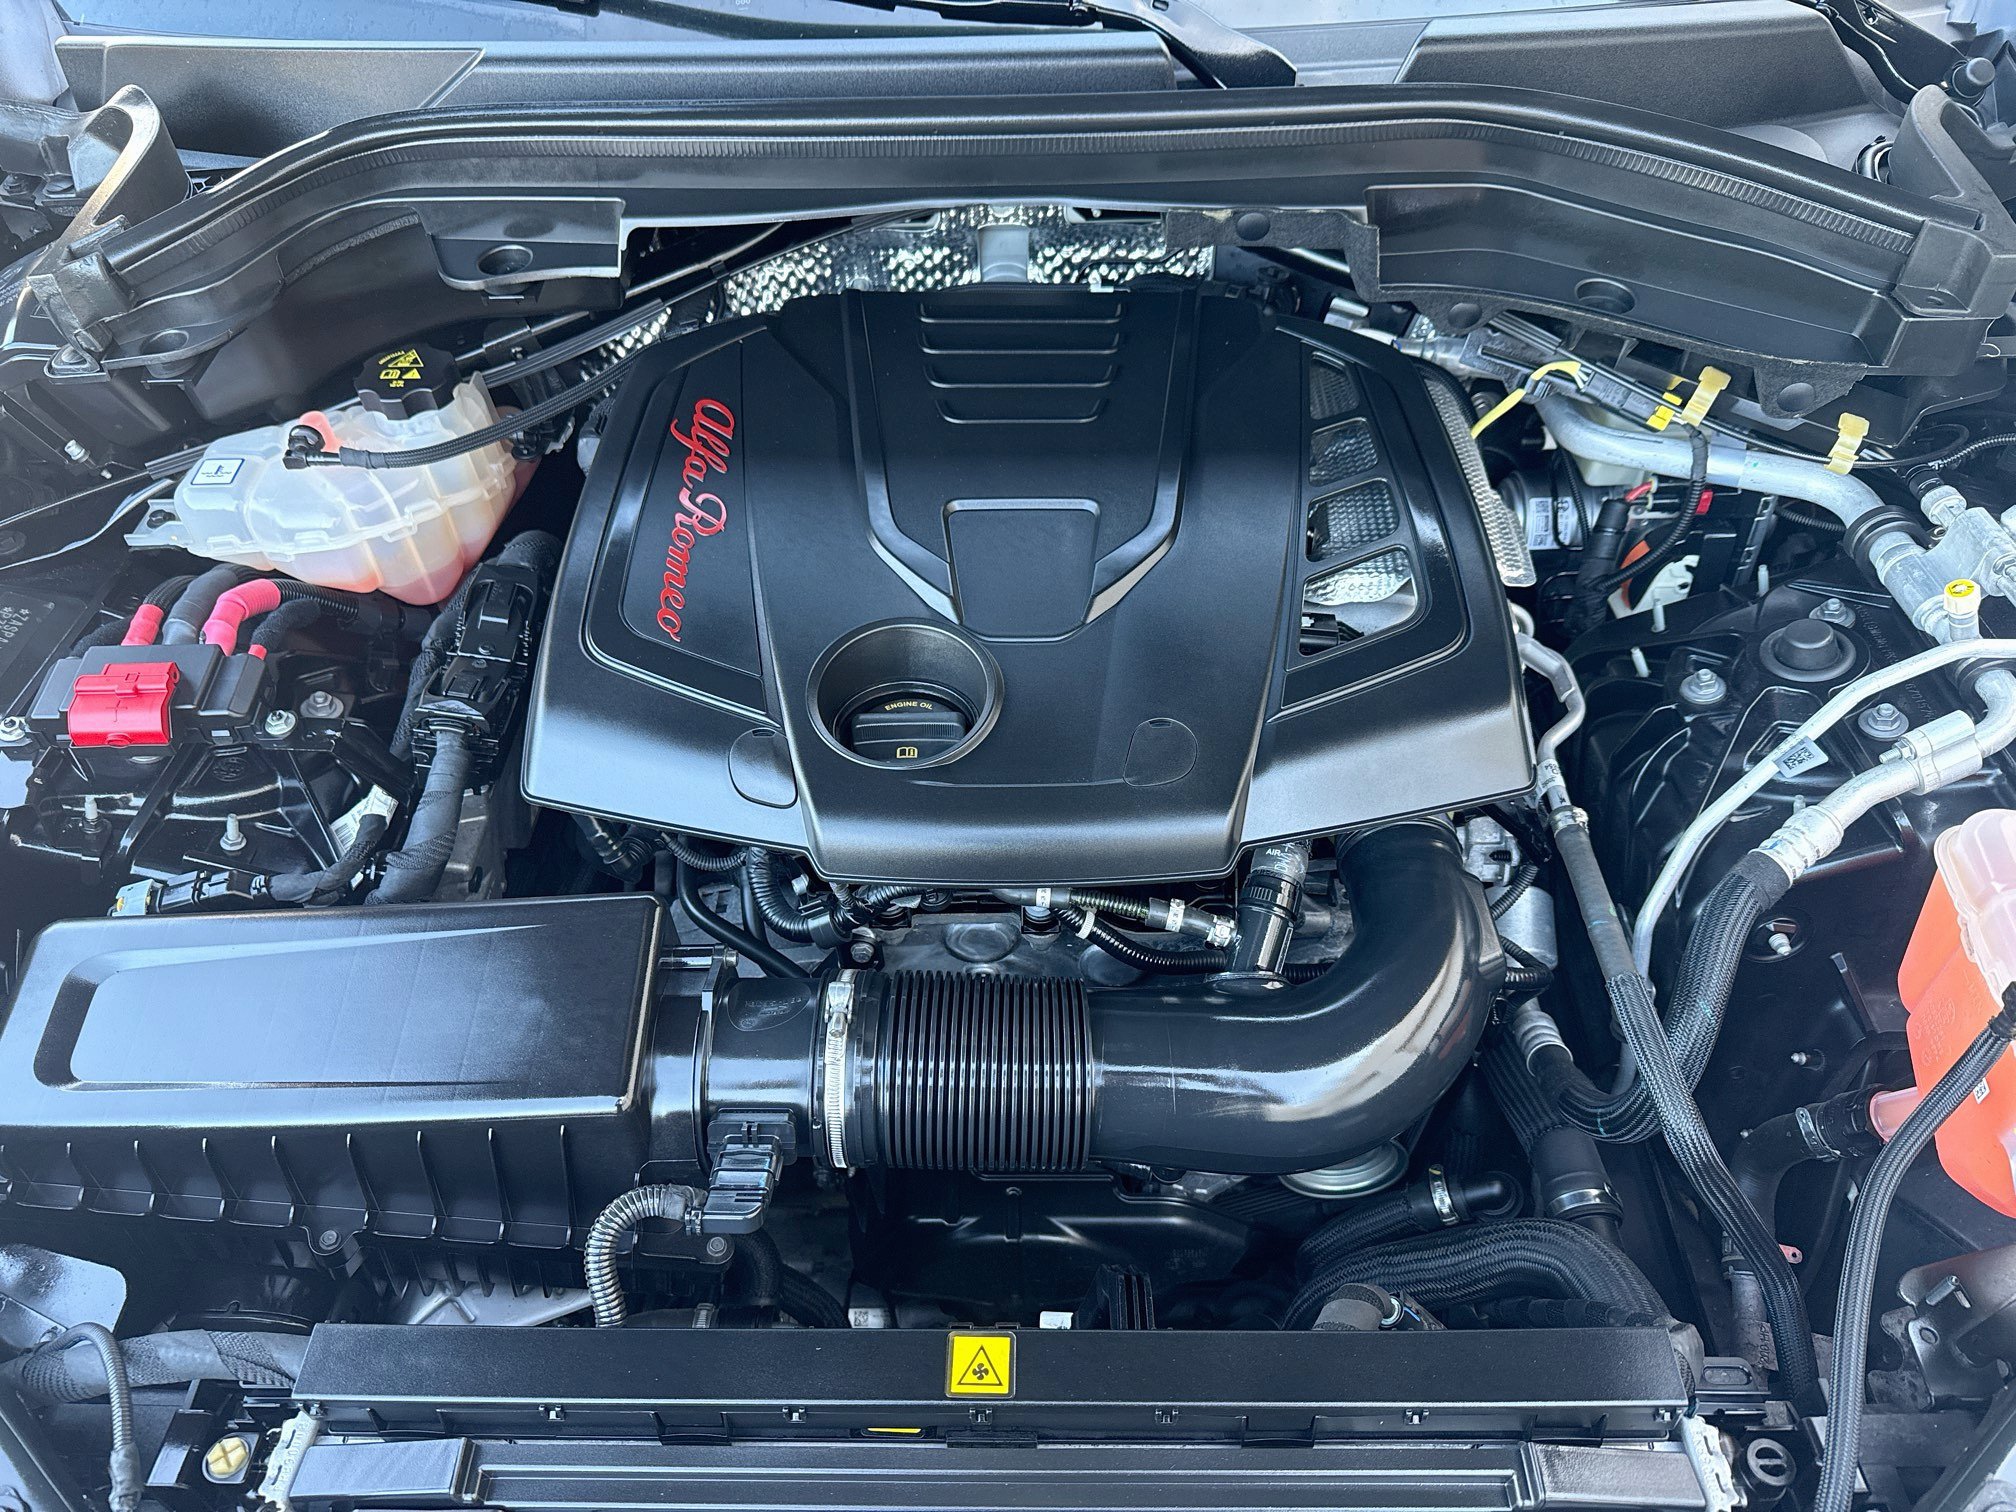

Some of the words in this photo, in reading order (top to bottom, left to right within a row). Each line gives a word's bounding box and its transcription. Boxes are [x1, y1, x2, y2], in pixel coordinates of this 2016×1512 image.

[670, 398, 735, 489] Alfa
[656, 486, 728, 642] Romeo
[884, 701, 918, 711] ENGINE
[919, 702, 933, 710] OIL
